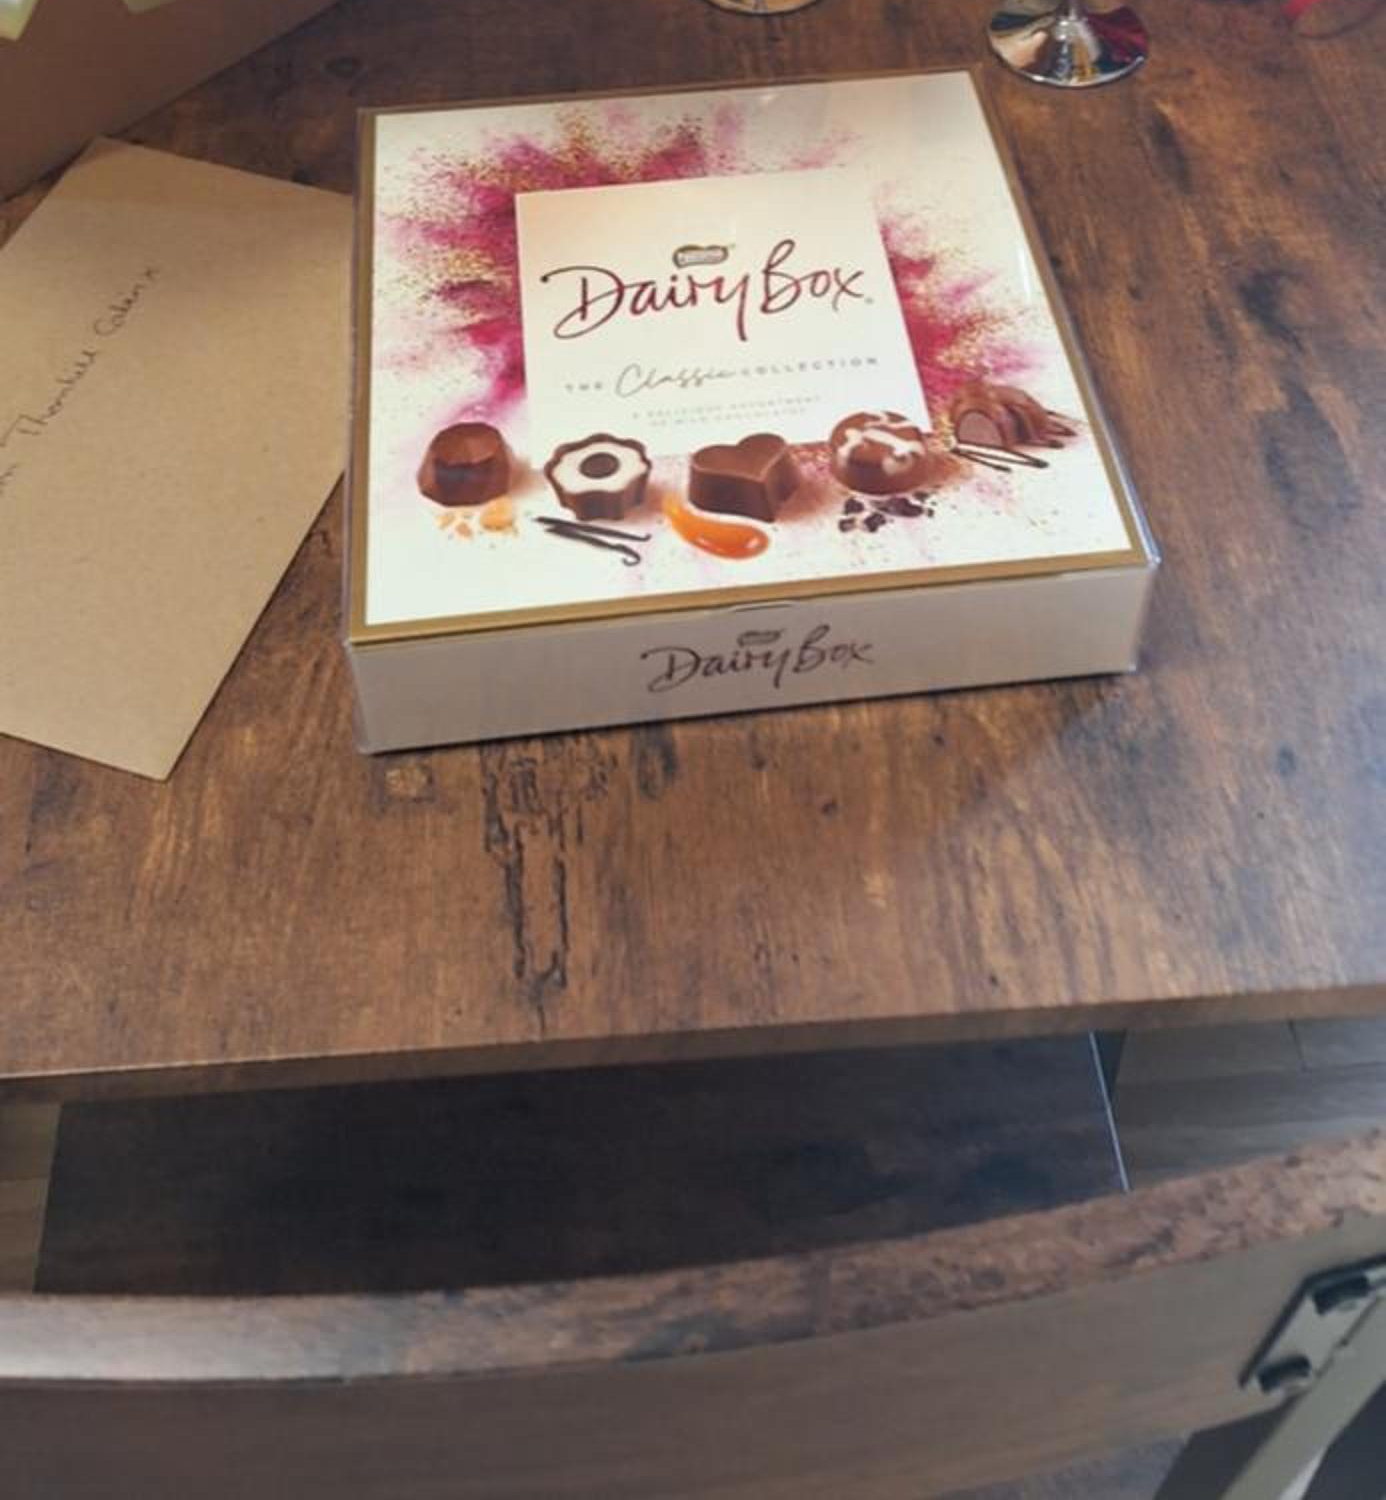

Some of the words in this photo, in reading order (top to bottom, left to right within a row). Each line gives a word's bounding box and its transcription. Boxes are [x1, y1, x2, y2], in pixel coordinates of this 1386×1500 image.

[540, 264, 751, 342] Dairy
[759, 238, 866, 314] Box
[614, 363, 737, 398] Classic
[739, 356, 880, 378] COLLECTION
[640, 645, 790, 693] Dairy
[793, 623, 875, 673] Box
